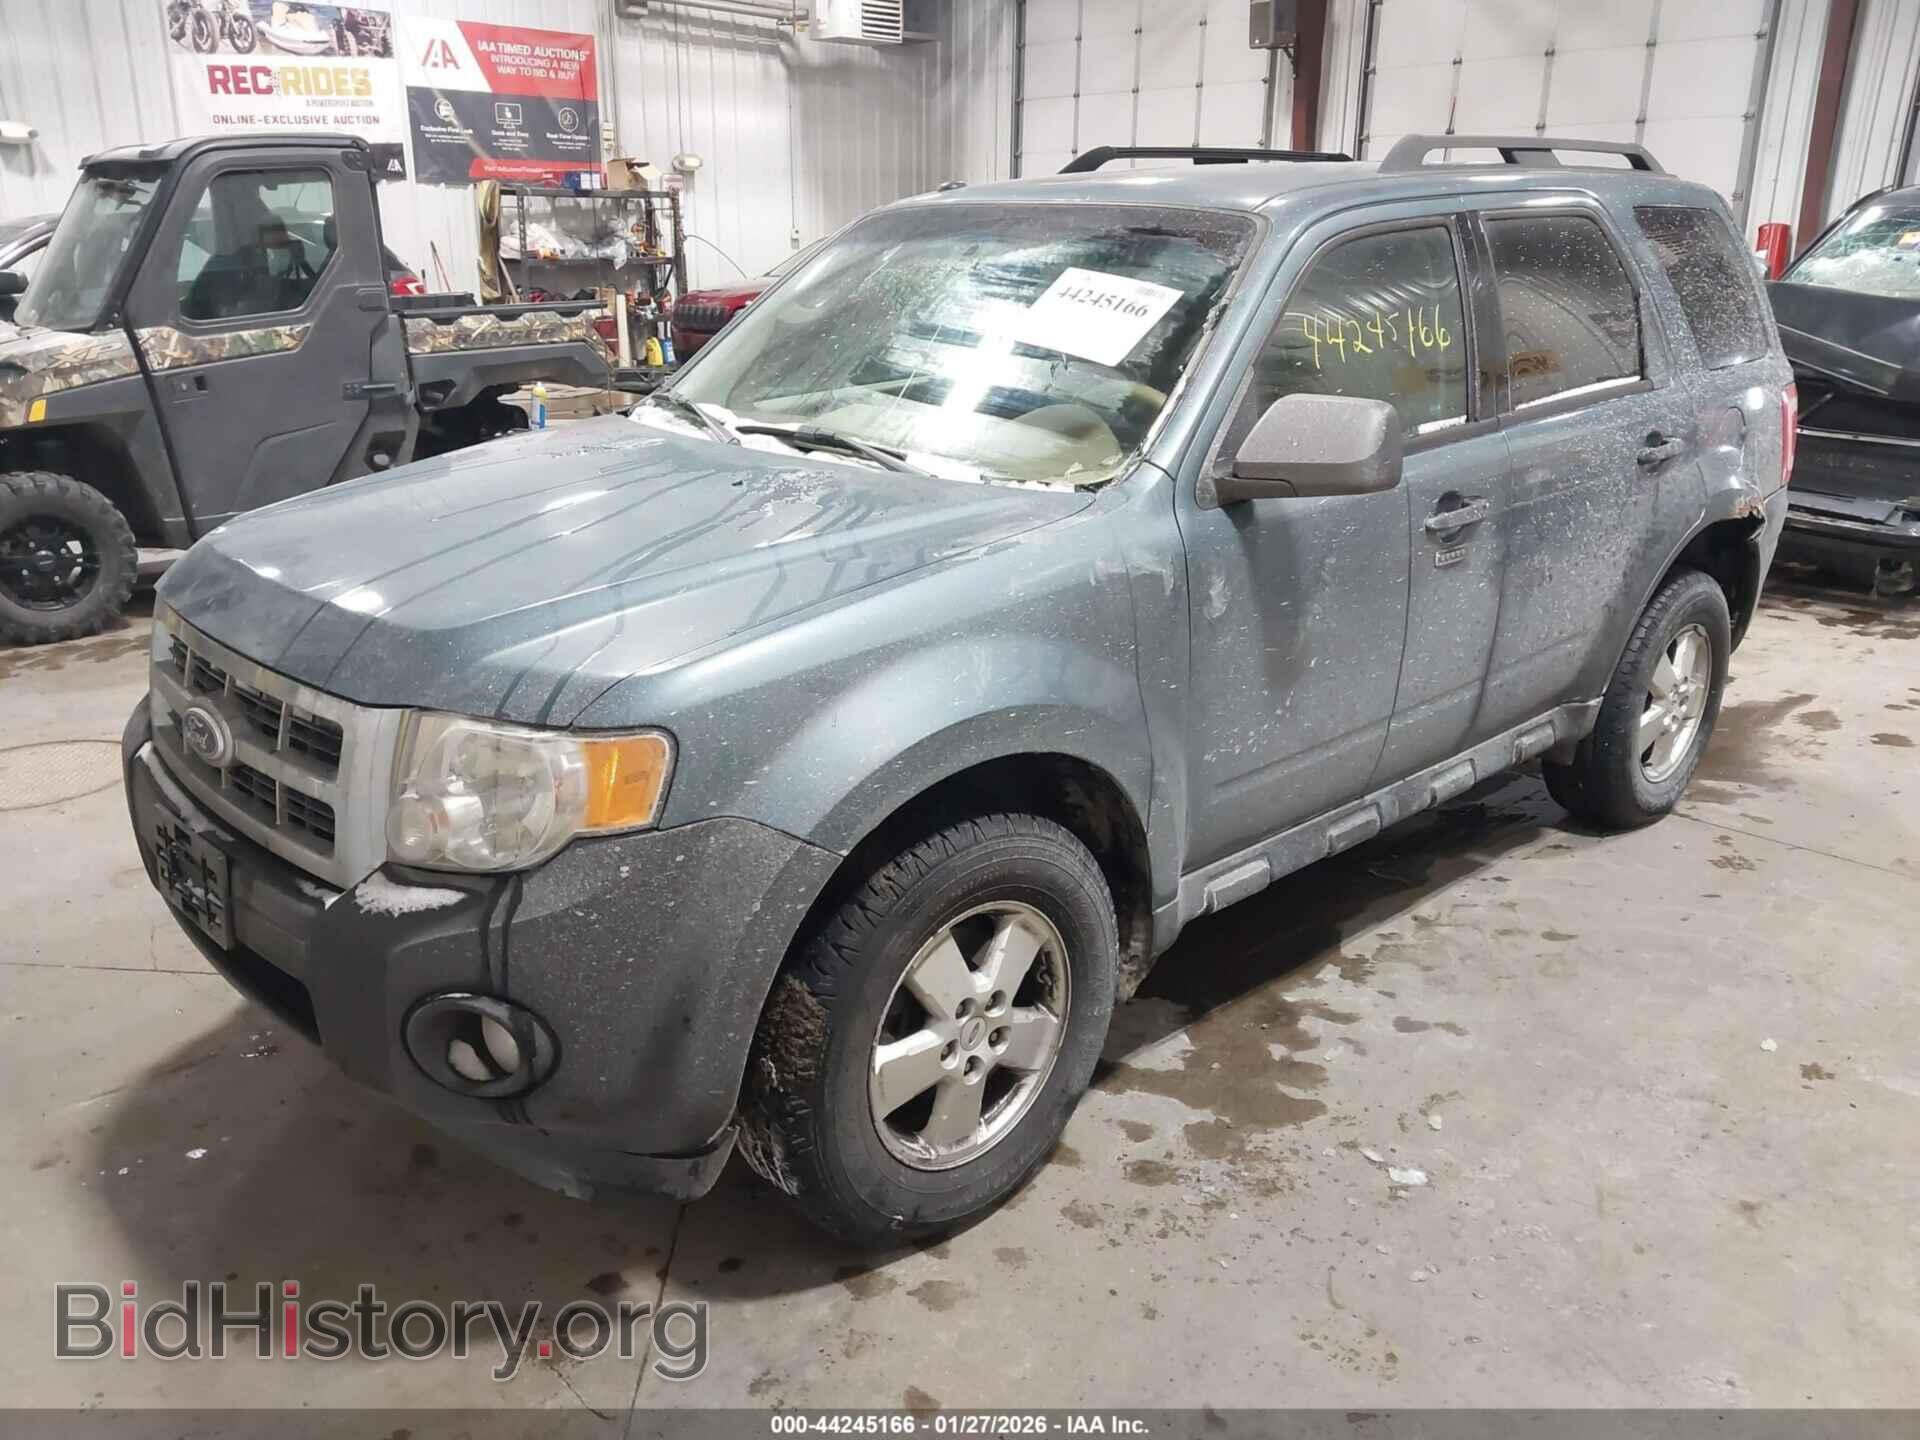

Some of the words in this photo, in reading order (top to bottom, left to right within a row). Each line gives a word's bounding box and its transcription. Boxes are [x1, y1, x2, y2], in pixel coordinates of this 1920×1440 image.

[496, 42, 531, 55] TIMED
[490, 54, 549, 68] INTRODUCING
[551, 59, 558, 68] A
[560, 61, 580, 71] NEW
[206, 64, 274, 95] REC
[280, 65, 372, 97] RIDES
[496, 65, 517, 75] WAY
[520, 67, 532, 76] TO
[533, 68, 547, 78] BID
[557, 70, 576, 80] BUY
[212, 114, 329, 125] ONLINE-EXCLUSIVE
[333, 115, 380, 125] AUCTION
[1057, 286, 1148, 318] 44245166
